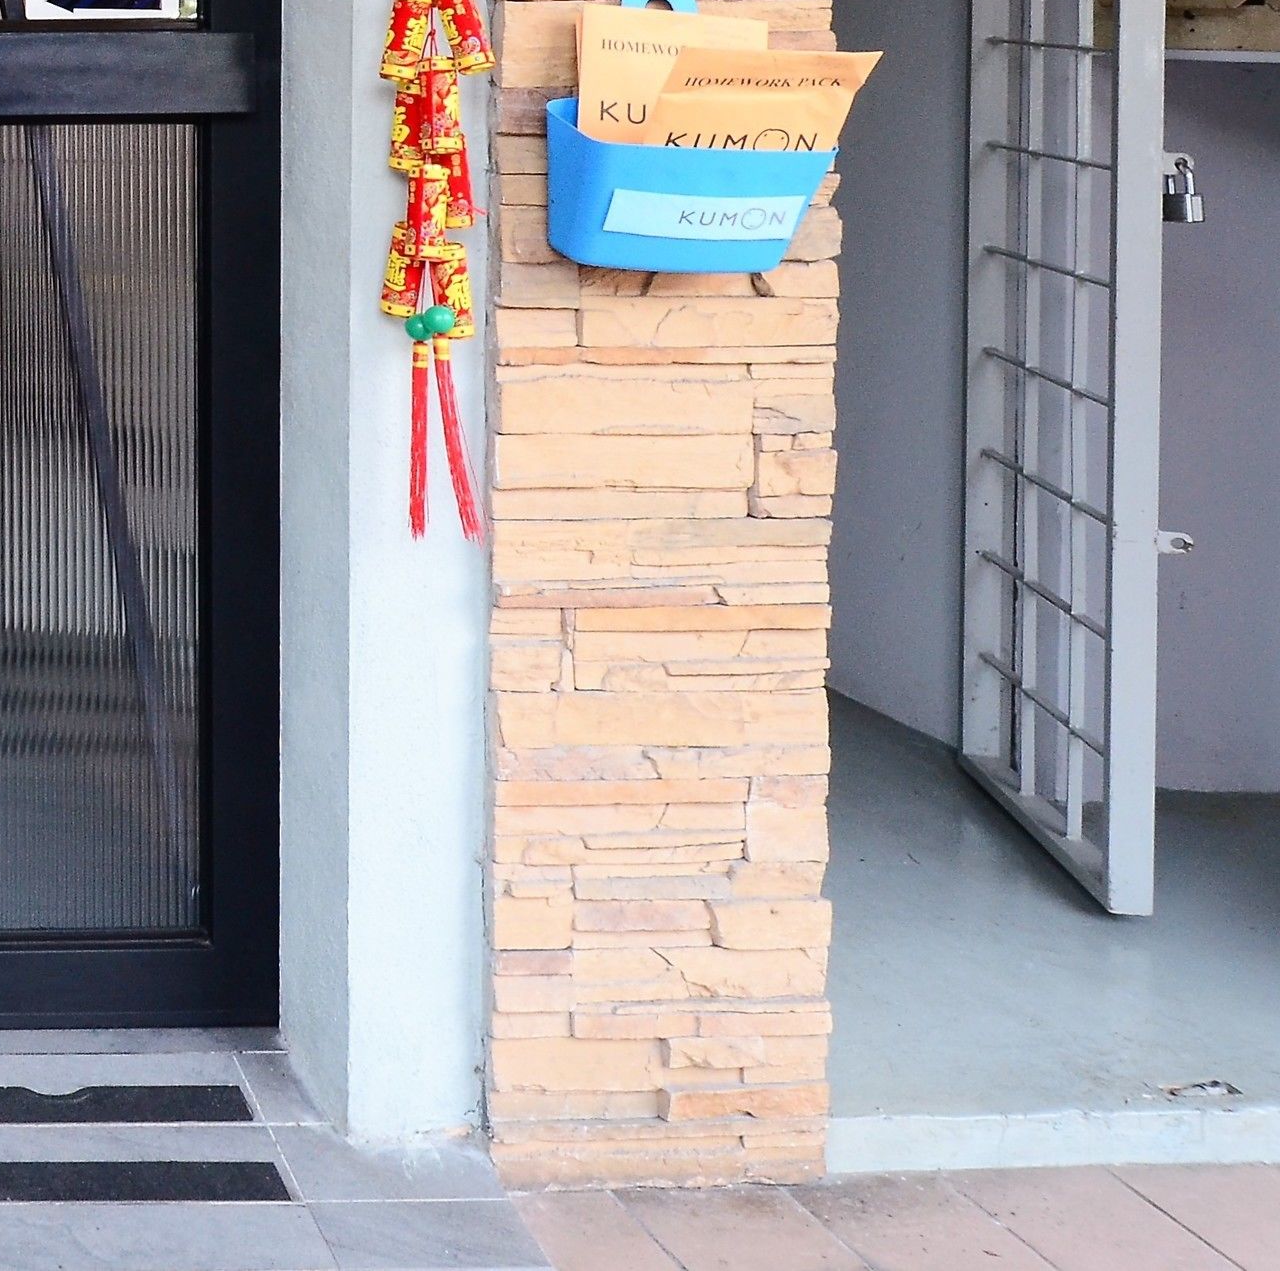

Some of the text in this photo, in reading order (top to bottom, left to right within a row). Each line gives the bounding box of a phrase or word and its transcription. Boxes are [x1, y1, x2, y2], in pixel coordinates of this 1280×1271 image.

[600, 38, 686, 58] HOMEWO
[684, 77, 842, 88] HOMEWORK PACK
[678, 207, 787, 230] KUMON
